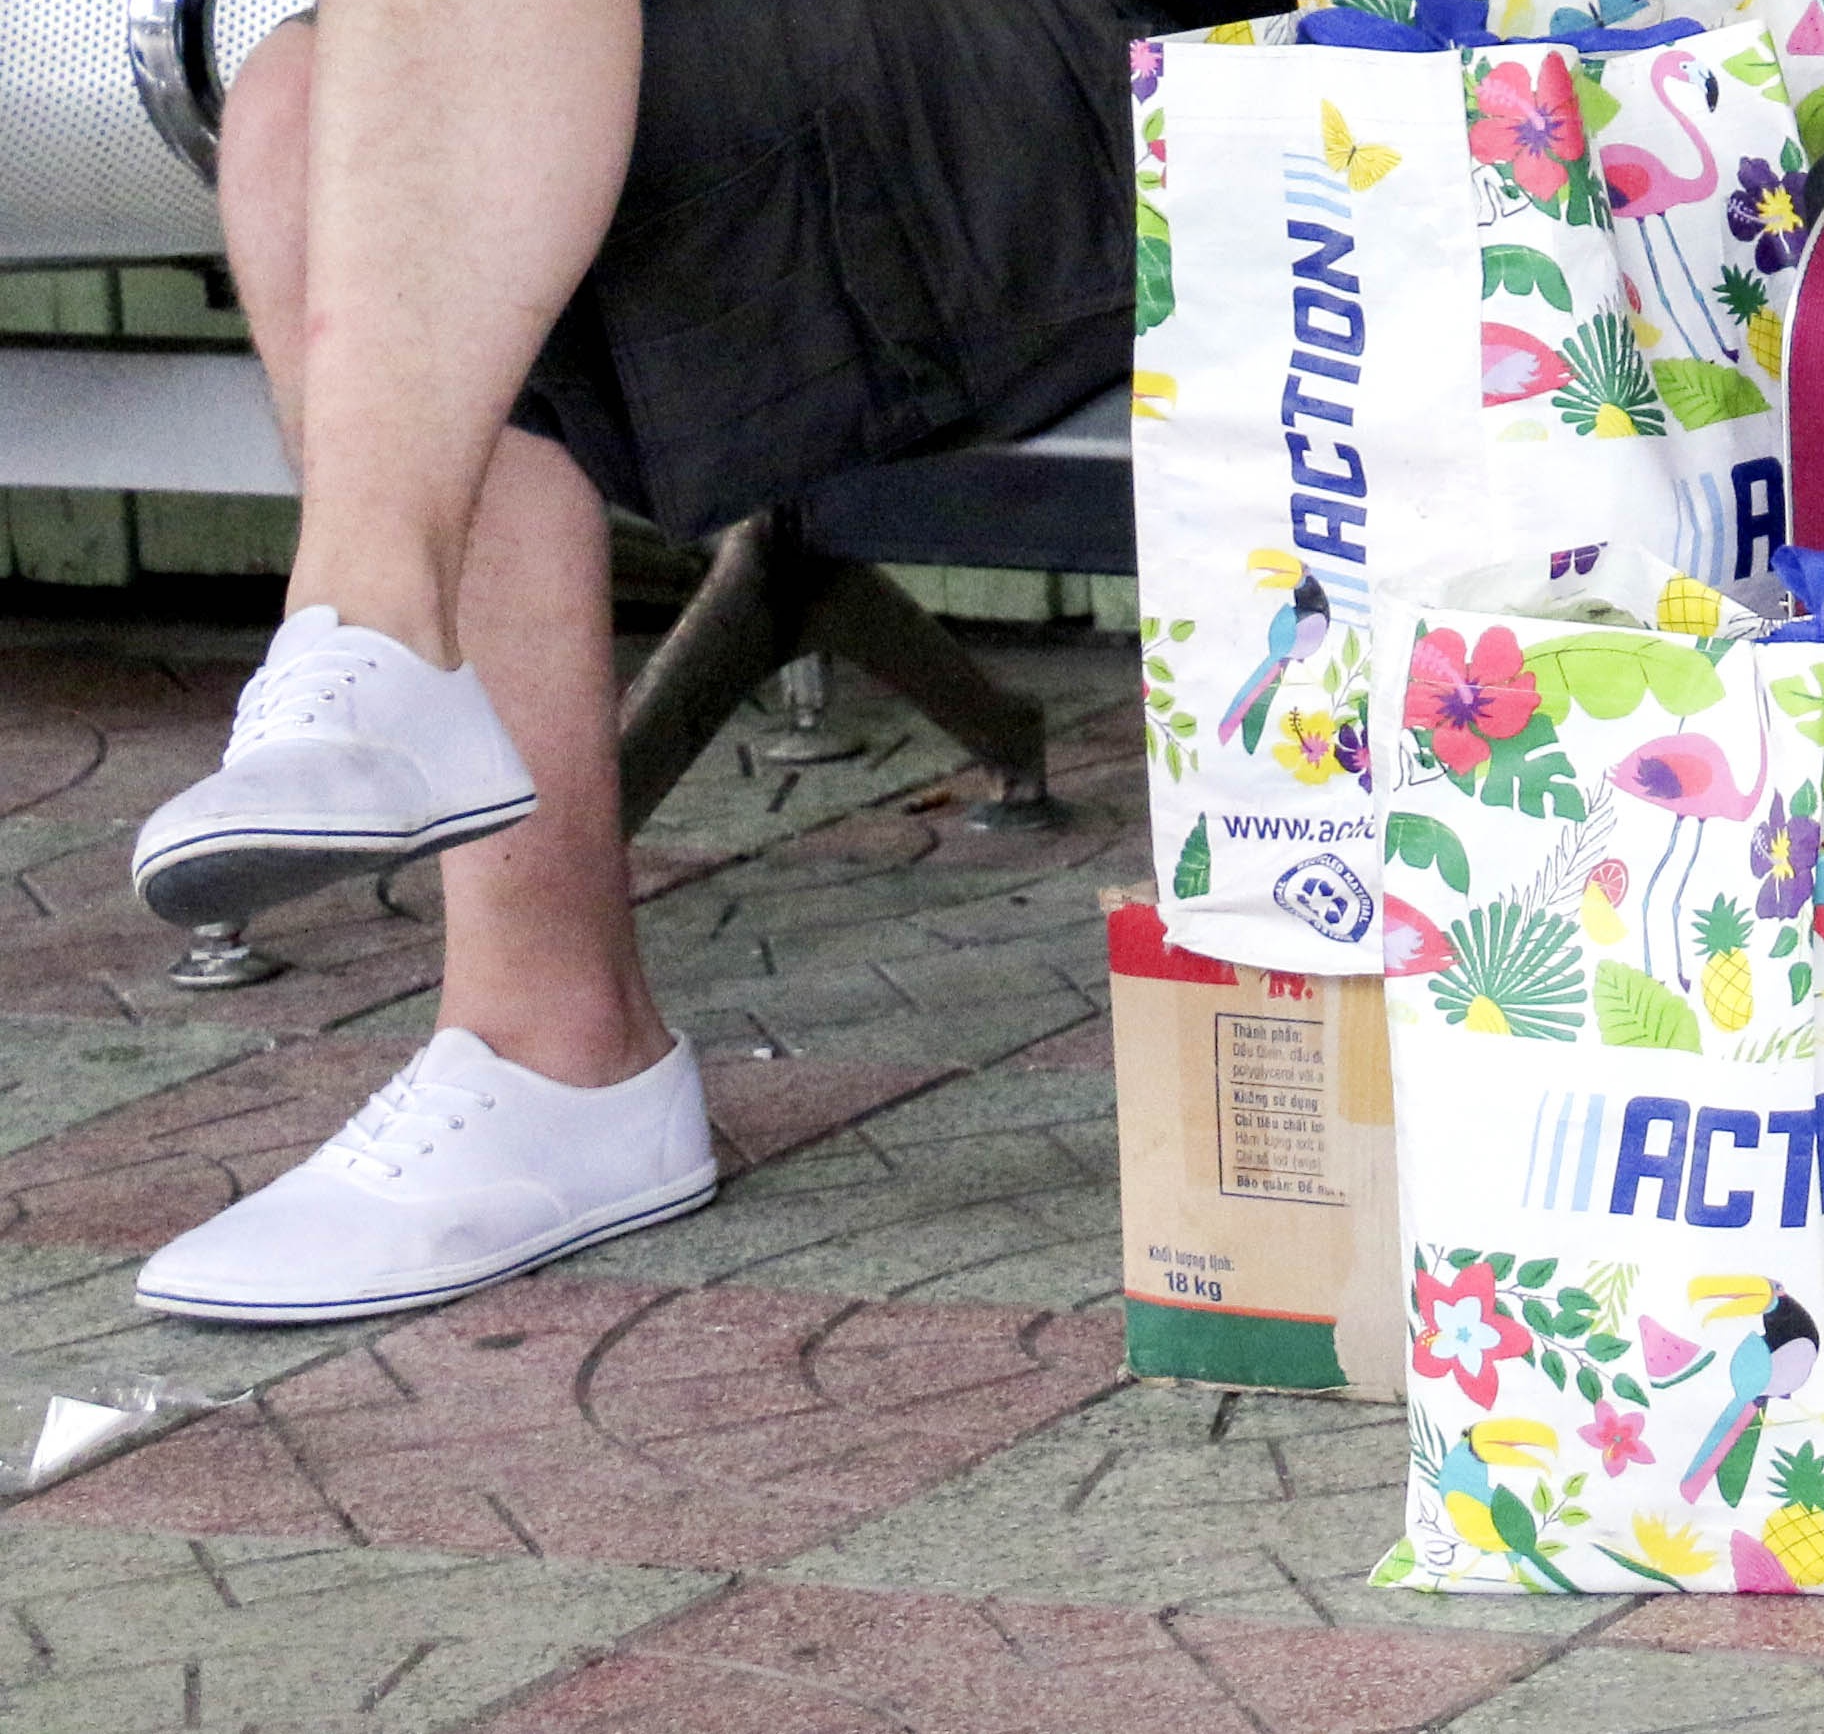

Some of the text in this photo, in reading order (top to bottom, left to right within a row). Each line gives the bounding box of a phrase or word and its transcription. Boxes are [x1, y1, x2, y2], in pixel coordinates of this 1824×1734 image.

[1281, 219, 1368, 566] ACTION
[1164, 1269, 1223, 1302] 18 kg
